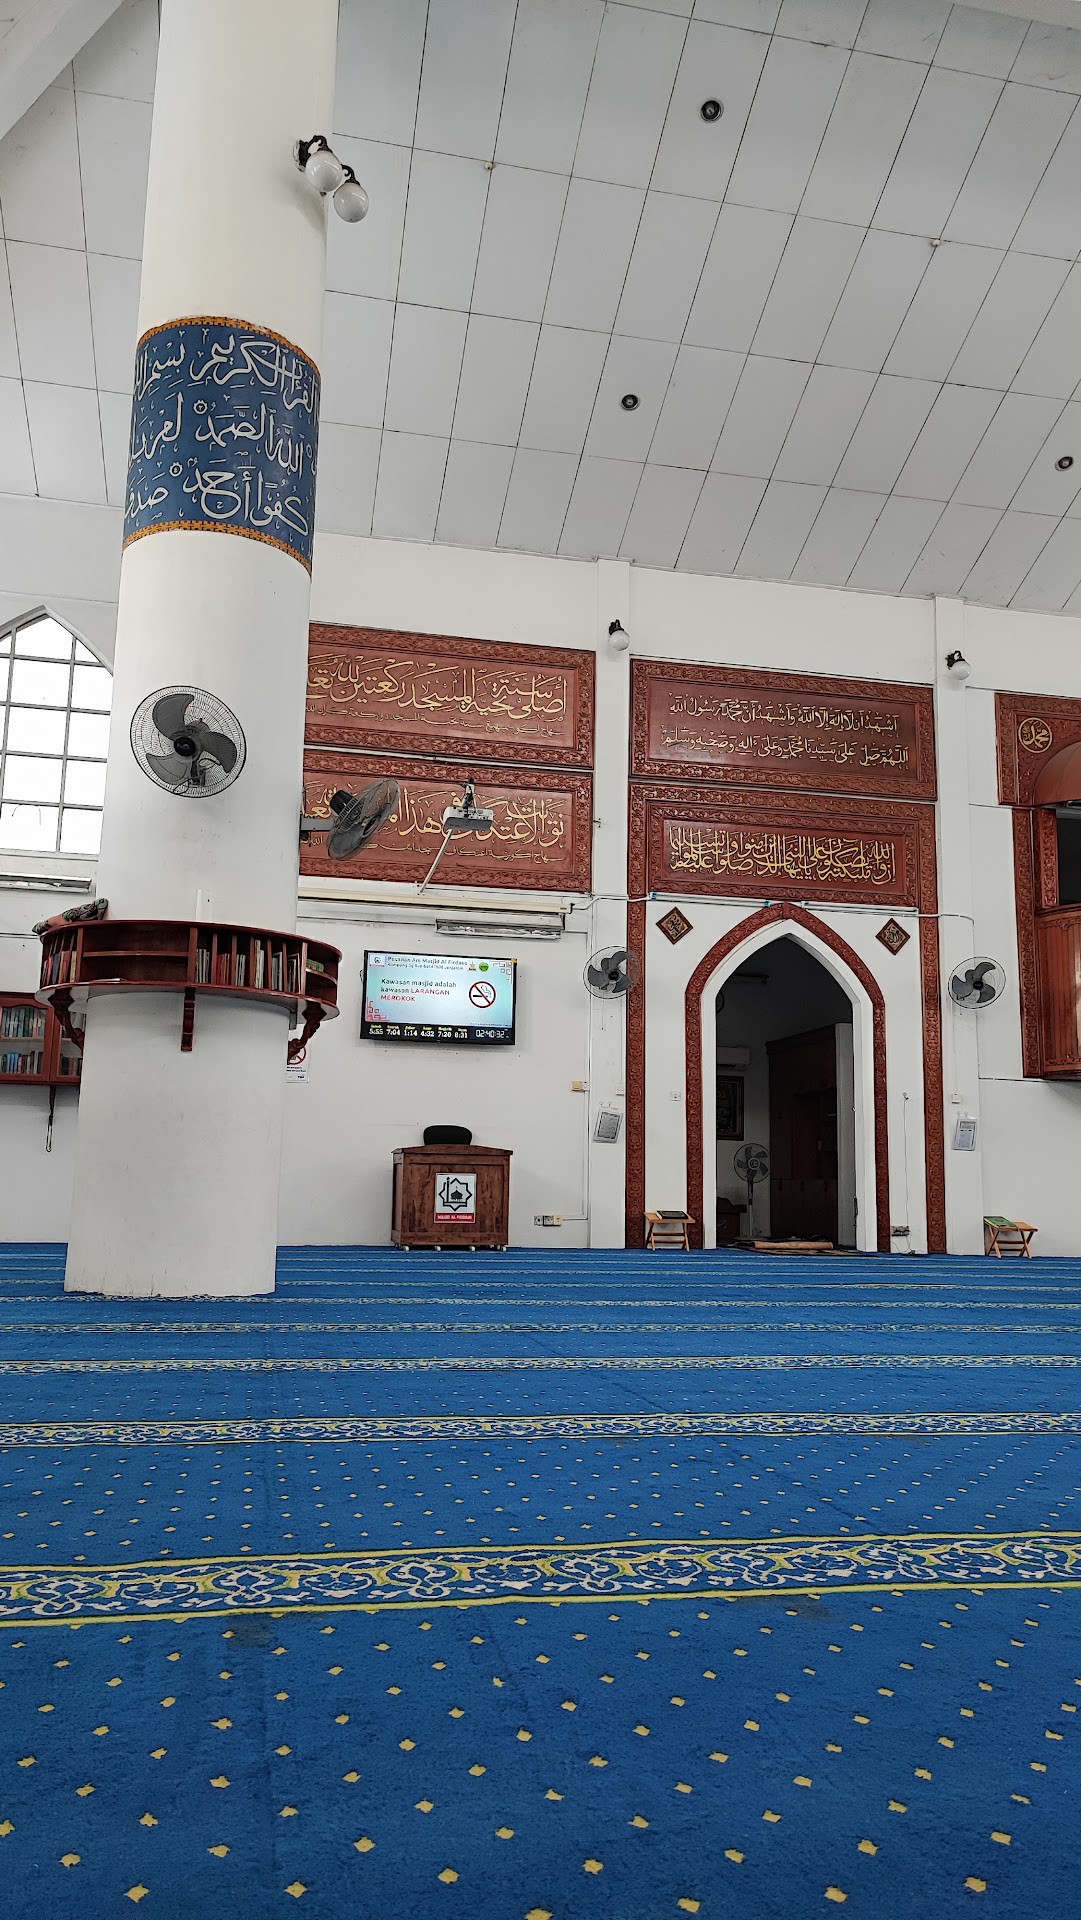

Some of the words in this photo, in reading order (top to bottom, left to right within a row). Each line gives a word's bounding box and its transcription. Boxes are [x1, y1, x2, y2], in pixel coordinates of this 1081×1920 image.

[138, 343, 186, 401] بسم
[195, 403, 276, 449] الصمد
[265, 437, 304, 480] الله
[183, 467, 250, 521] أحد
[398, 668, 476, 711] المسجد
[798, 706, 816, 724] الله
